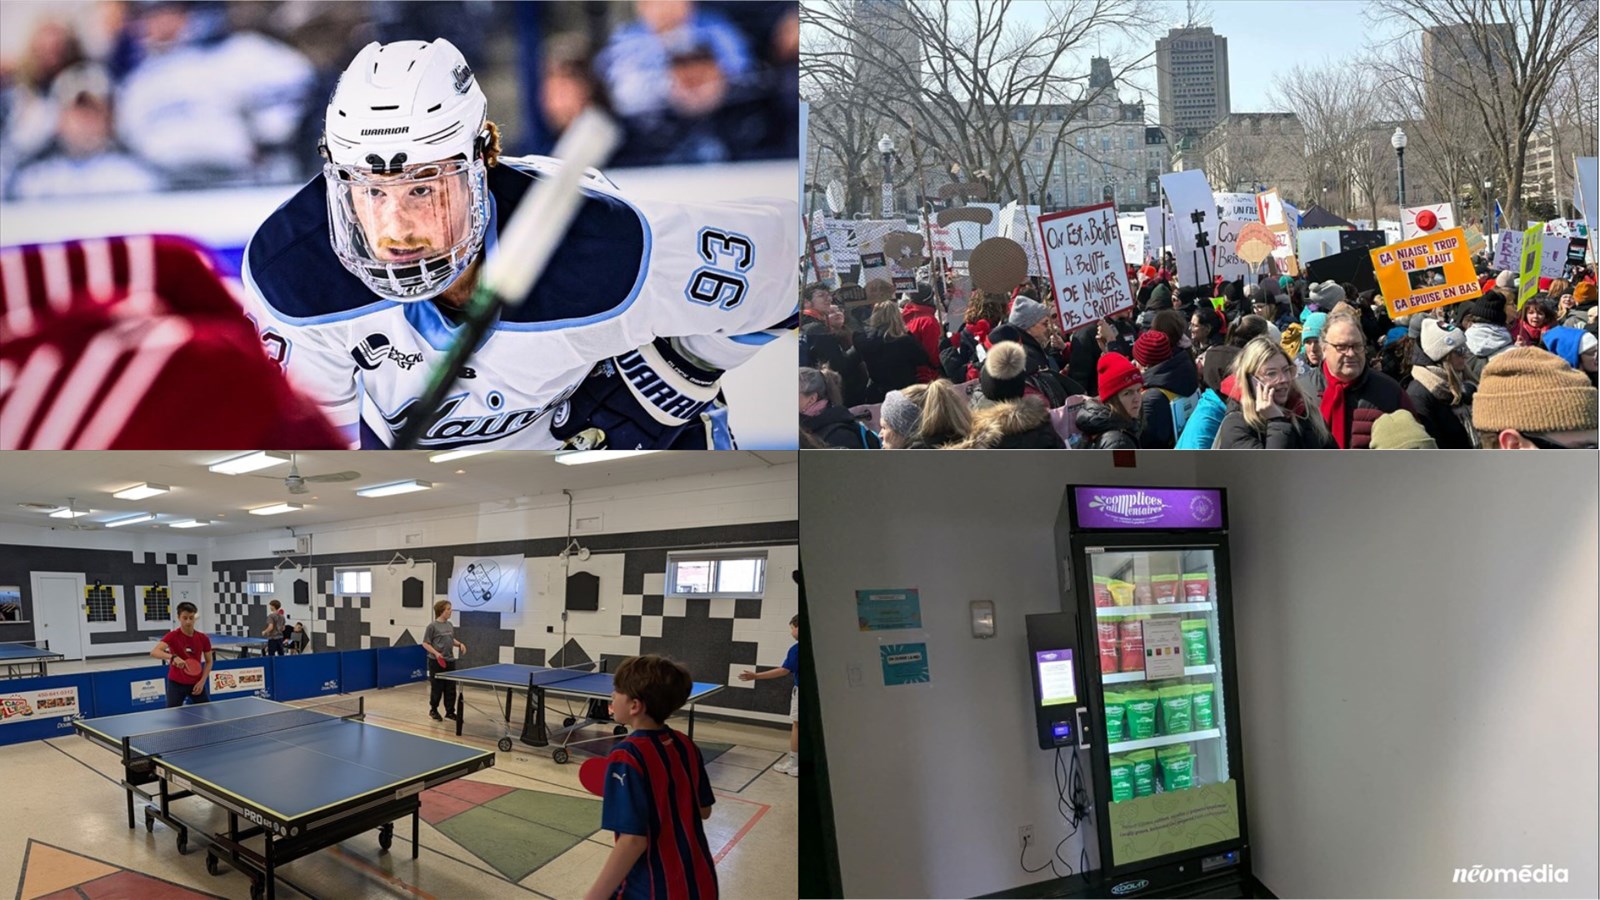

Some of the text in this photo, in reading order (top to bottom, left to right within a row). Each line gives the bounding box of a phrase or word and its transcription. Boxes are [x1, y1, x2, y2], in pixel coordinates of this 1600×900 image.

[360, 126, 410, 136] WARRIOR
[1379, 238, 1457, 266] ÇA NIAISE TROP
[684, 226, 756, 311] 93
[1402, 253, 1452, 271] EN HAUT
[1063, 272, 1122, 302] DE MANGER
[1395, 282, 1478, 311] ÇA ÉPUISE EN BAS
[1064, 310, 1082, 328] DES
[1105, 491, 1162, 508] complices
[244, 807, 263, 826] PRO
